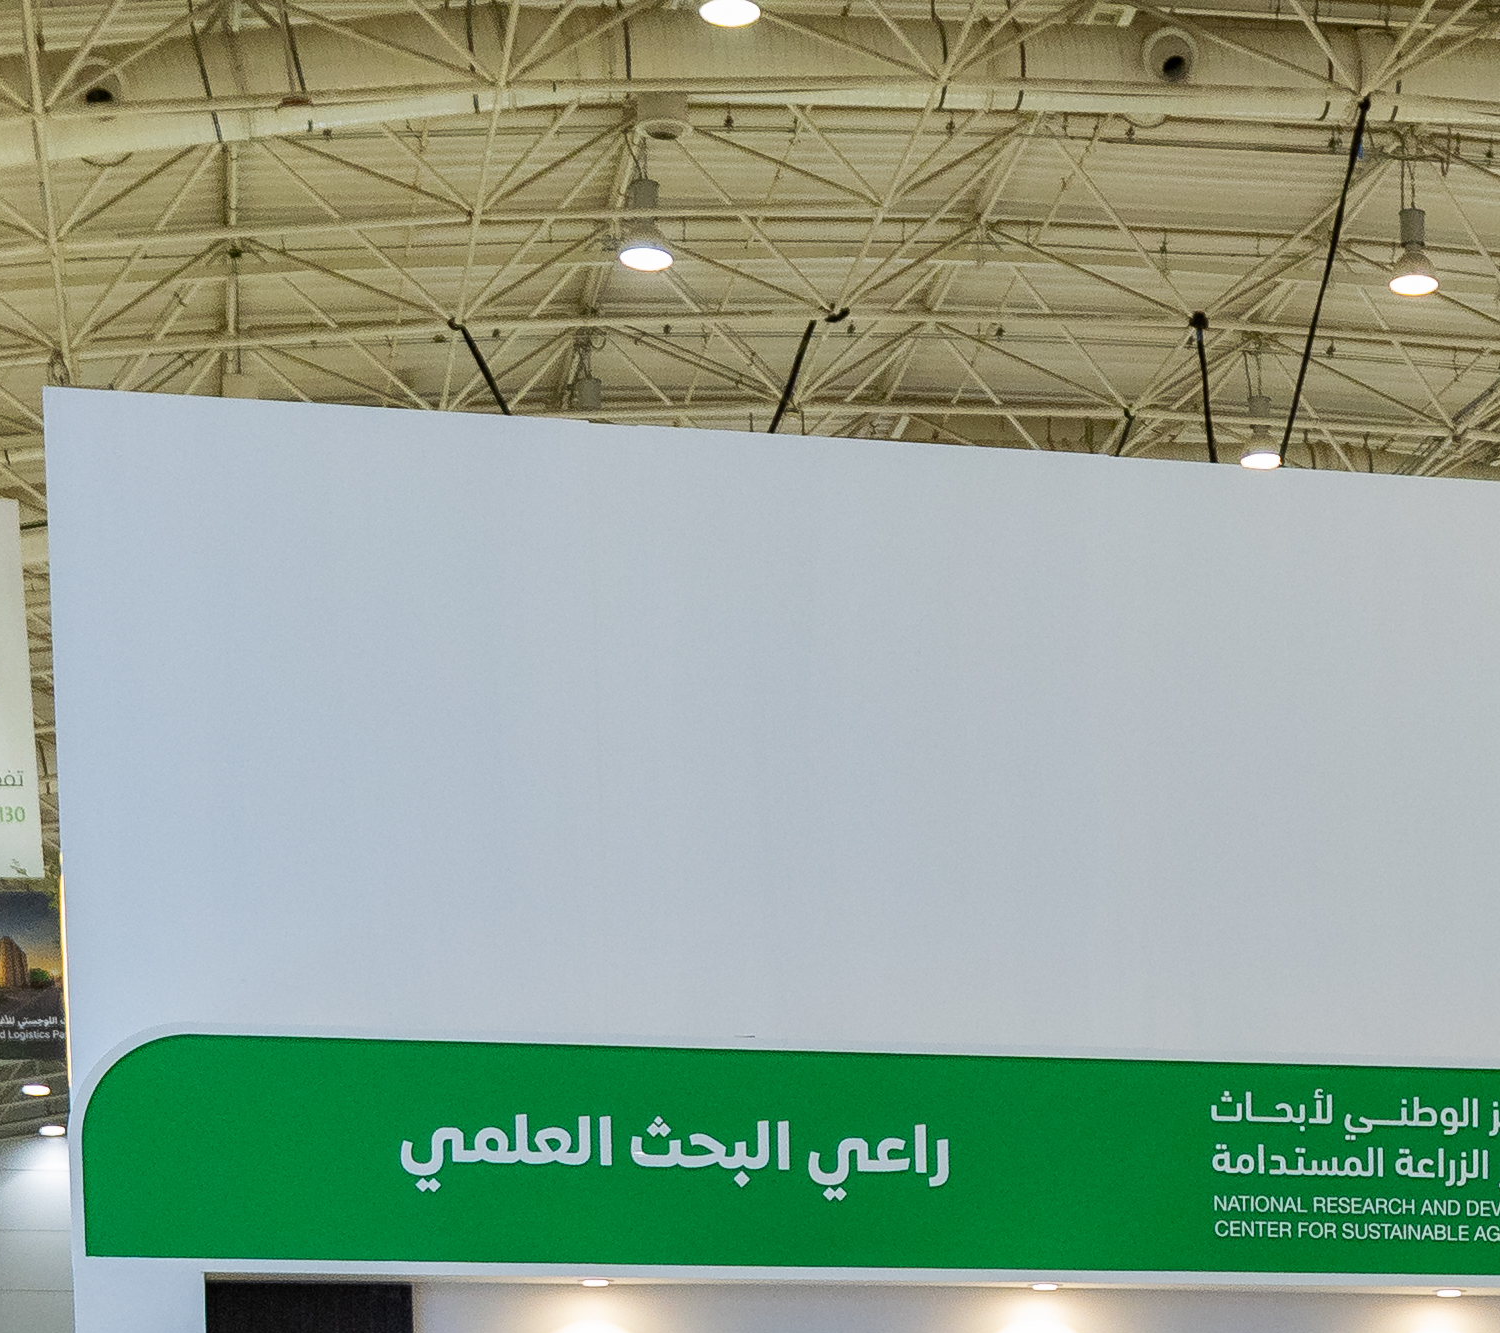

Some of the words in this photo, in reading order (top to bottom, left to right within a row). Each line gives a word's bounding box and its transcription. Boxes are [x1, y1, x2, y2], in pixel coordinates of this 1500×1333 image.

[8, 1030, 50, 1041] Logistics
[1210, 1088, 1333, 1132] لأبحاث
[1344, 1096, 1478, 1141] الوطني
[400, 1113, 613, 1193] العلمي
[630, 1115, 790, 1189] البحث
[807, 1124, 950, 1201] راعي
[1212, 1143, 1383, 1176] المستدامة
[1395, 1148, 1488, 1186] الزراعة
[1214, 1195, 1308, 1214] NATIONAL
[1314, 1197, 1415, 1215] RESEARCH
[1420, 1199, 1460, 1216] AND
[1214, 1220, 1291, 1238] CENTER
[1299, 1222, 1336, 1239] FOR
[1342, 1223, 1469, 1241] SUSTAINABLE
